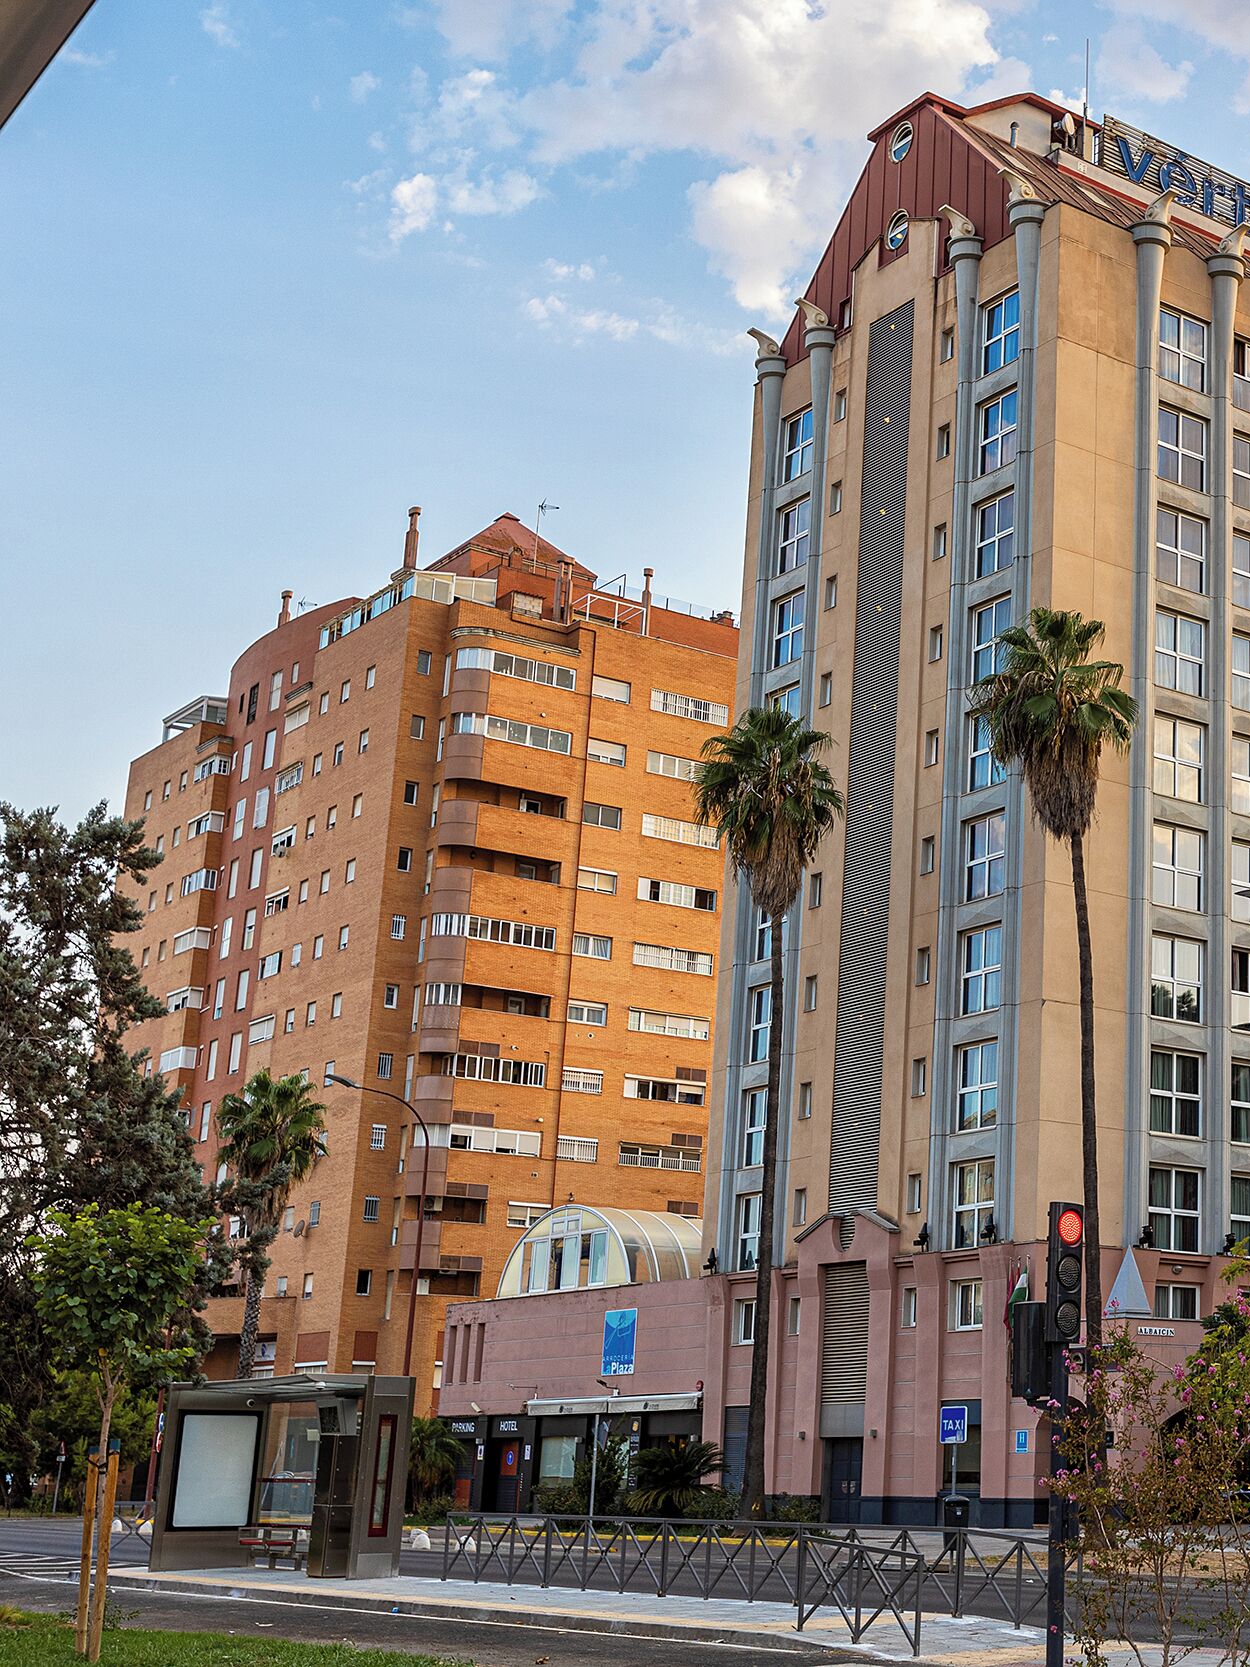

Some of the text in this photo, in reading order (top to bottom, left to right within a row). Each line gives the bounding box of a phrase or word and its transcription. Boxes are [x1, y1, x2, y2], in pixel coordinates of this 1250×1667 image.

[451, 1422, 475, 1433] PARKING
[499, 1420, 518, 1432] HOTEL
[942, 1419, 964, 1431] TAXI
